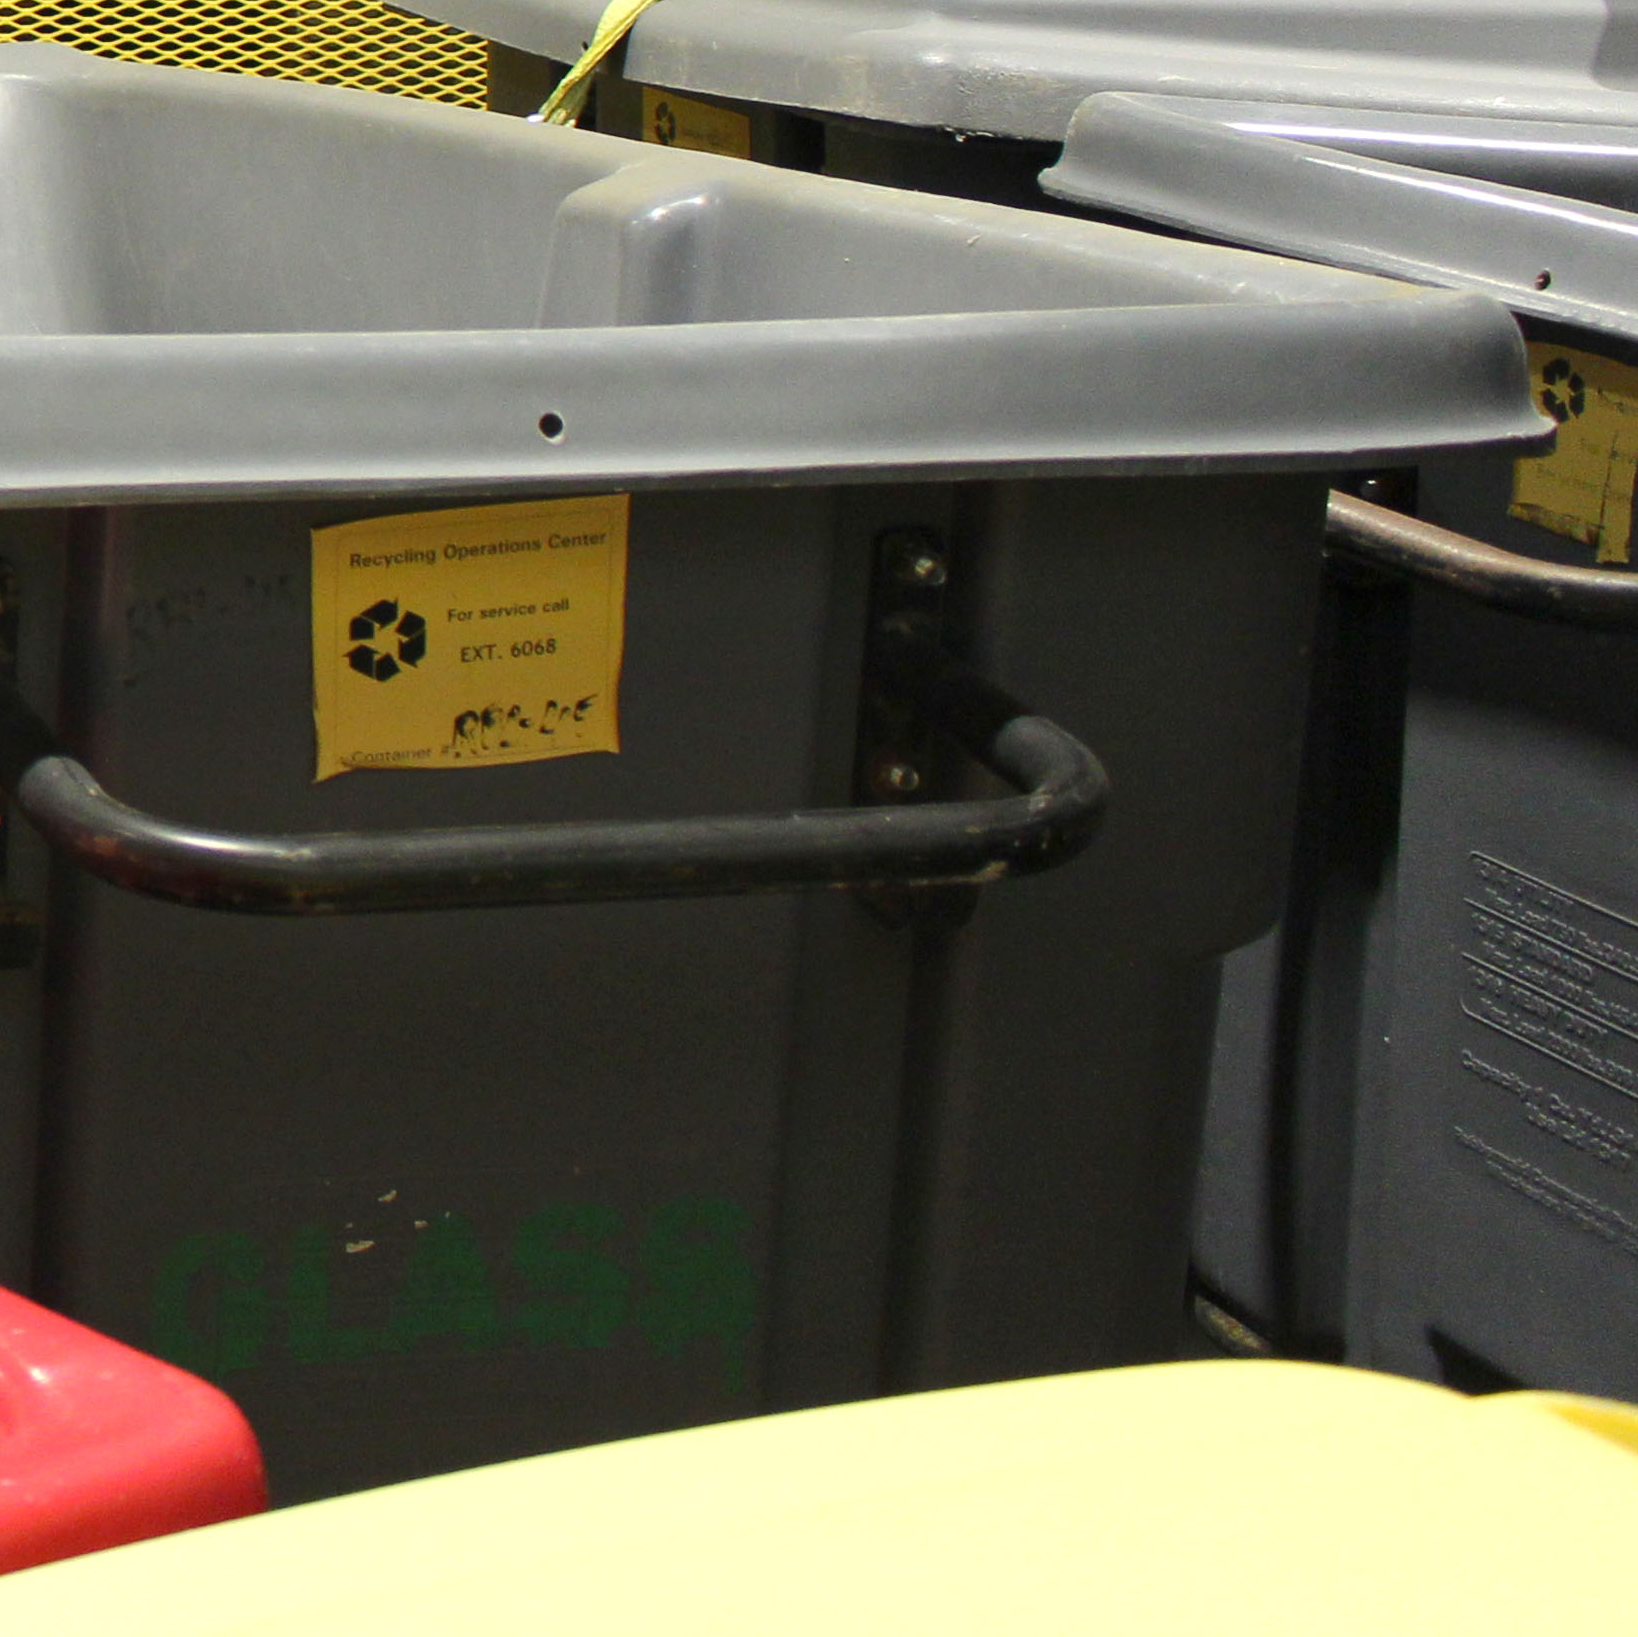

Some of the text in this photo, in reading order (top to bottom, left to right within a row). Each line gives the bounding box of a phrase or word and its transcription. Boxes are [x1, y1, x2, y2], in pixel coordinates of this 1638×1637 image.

[349, 532, 607, 569] Recycling Operations Center
[447, 599, 570, 623] For service call
[460, 638, 557, 663] EXT. 6068
[351, 748, 433, 764] Container
